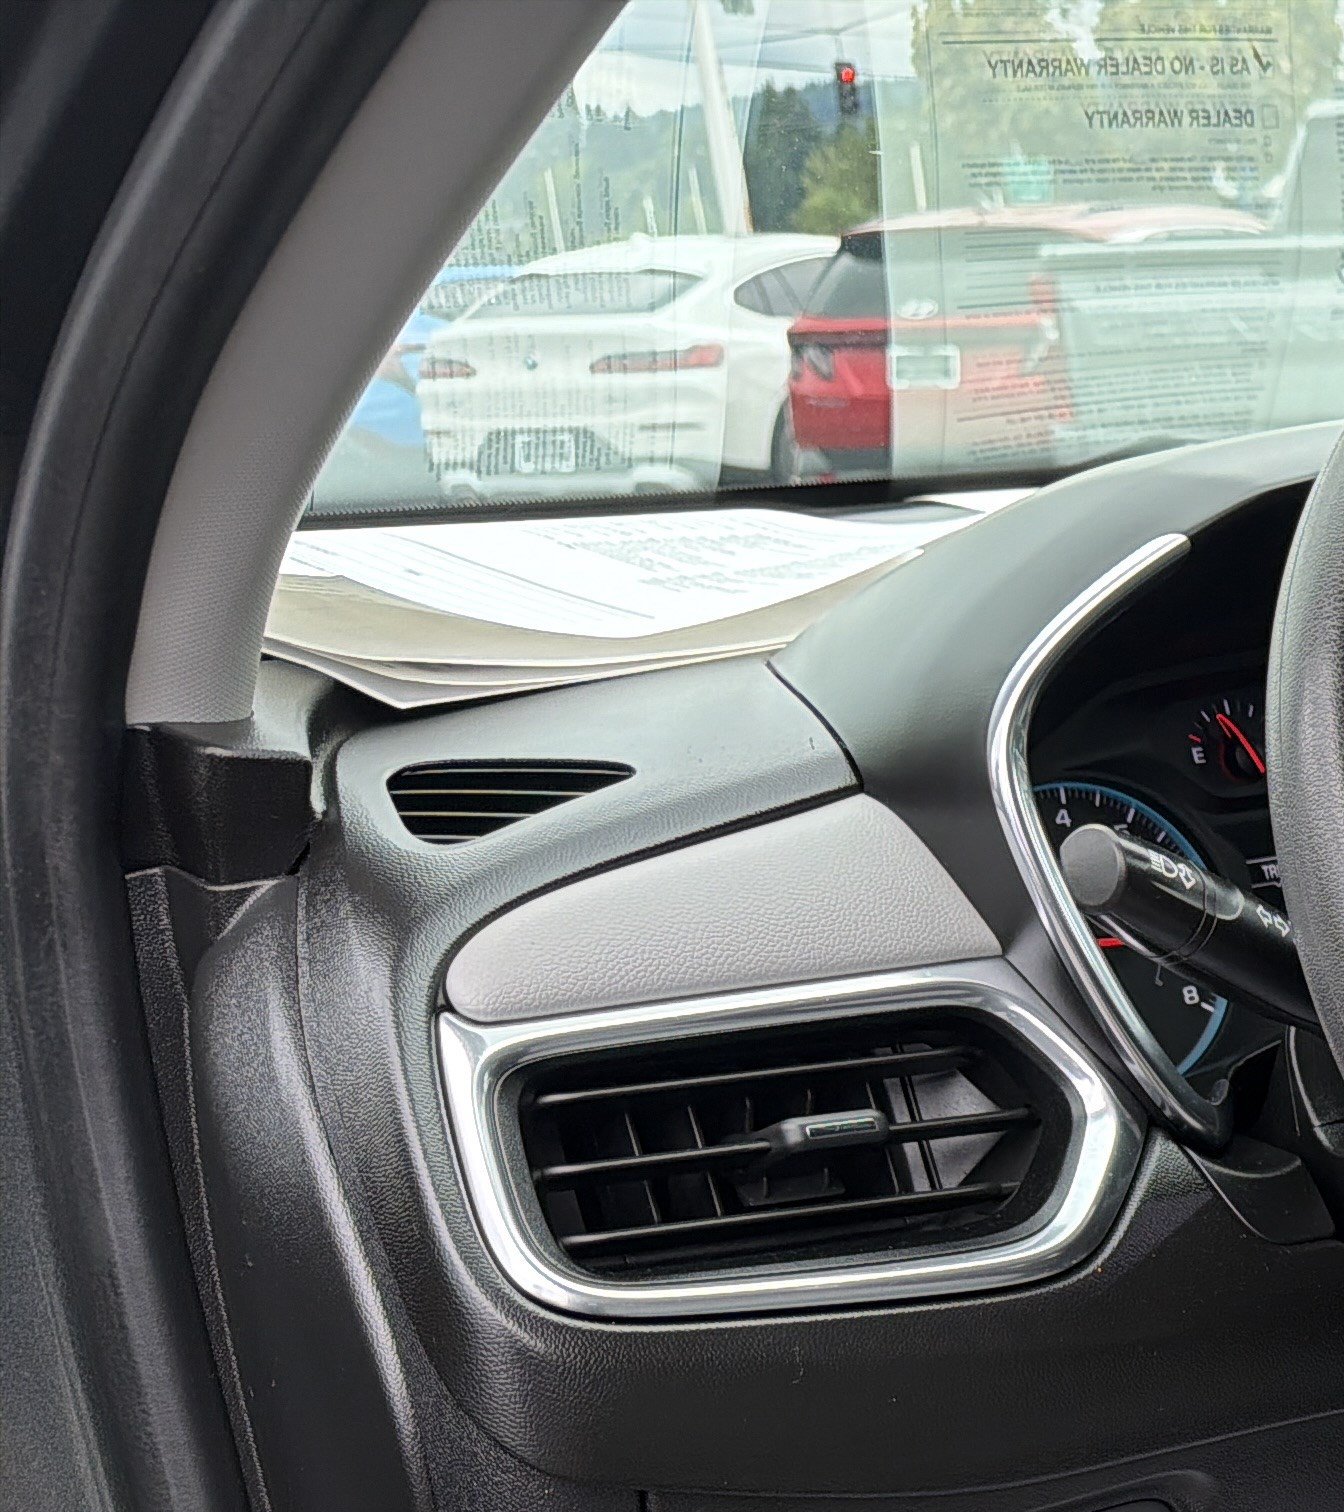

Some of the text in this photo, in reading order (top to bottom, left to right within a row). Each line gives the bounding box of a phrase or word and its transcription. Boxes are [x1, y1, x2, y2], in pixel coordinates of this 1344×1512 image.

[1190, 746, 1206, 764] E
[1055, 808, 1072, 827] 4
[1182, 985, 1200, 1005] 8
